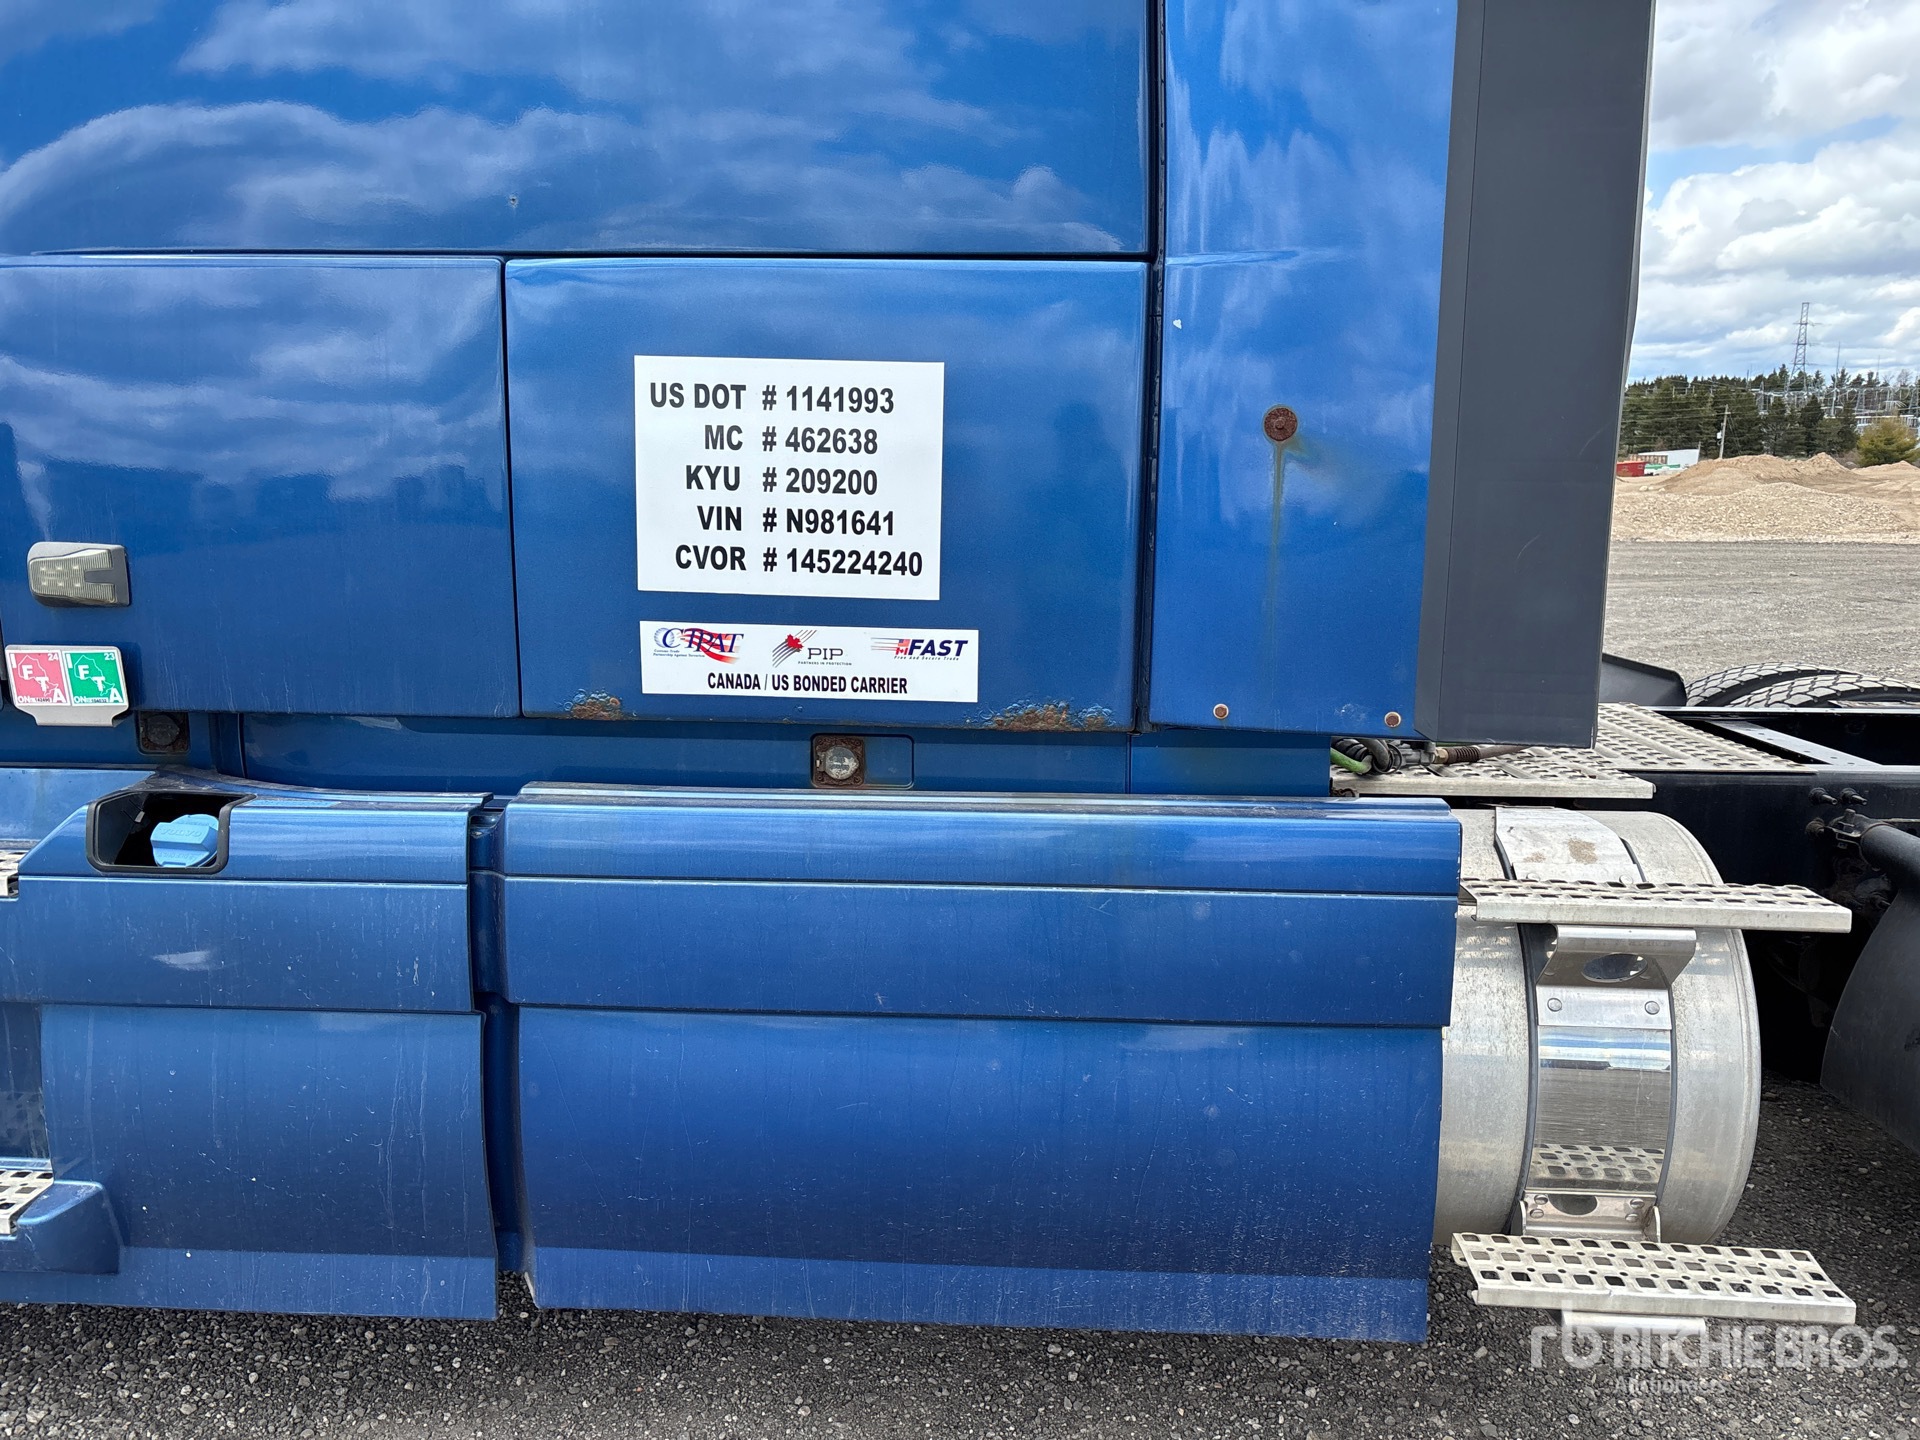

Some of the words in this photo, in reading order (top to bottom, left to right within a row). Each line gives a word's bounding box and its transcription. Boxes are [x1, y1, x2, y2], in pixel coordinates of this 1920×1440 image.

[650, 382, 684, 408] US
[694, 383, 746, 410] DOT
[762, 385, 777, 411] #
[786, 386, 895, 414] 1141993
[704, 425, 743, 451] MC
[762, 426, 777, 452] #
[785, 426, 878, 454] 462638
[686, 465, 740, 491] KYU
[762, 467, 777, 492] #
[785, 467, 878, 495] 209200
[697, 505, 743, 531] VIN
[762, 508, 777, 533] #
[786, 508, 894, 536] N981641
[675, 545, 747, 571] CVOR
[763, 547, 777, 572] #
[786, 548, 923, 576] 145224240
[47, 653, 59, 661] 24
[104, 652, 115, 661] 23
[807, 647, 844, 660] PIP
[908, 639, 968, 656] FAST
[707, 672, 761, 690] CANADA
[771, 674, 789, 691] US
[793, 675, 847, 692] BONDED
[851, 676, 908, 694] CARRIER
